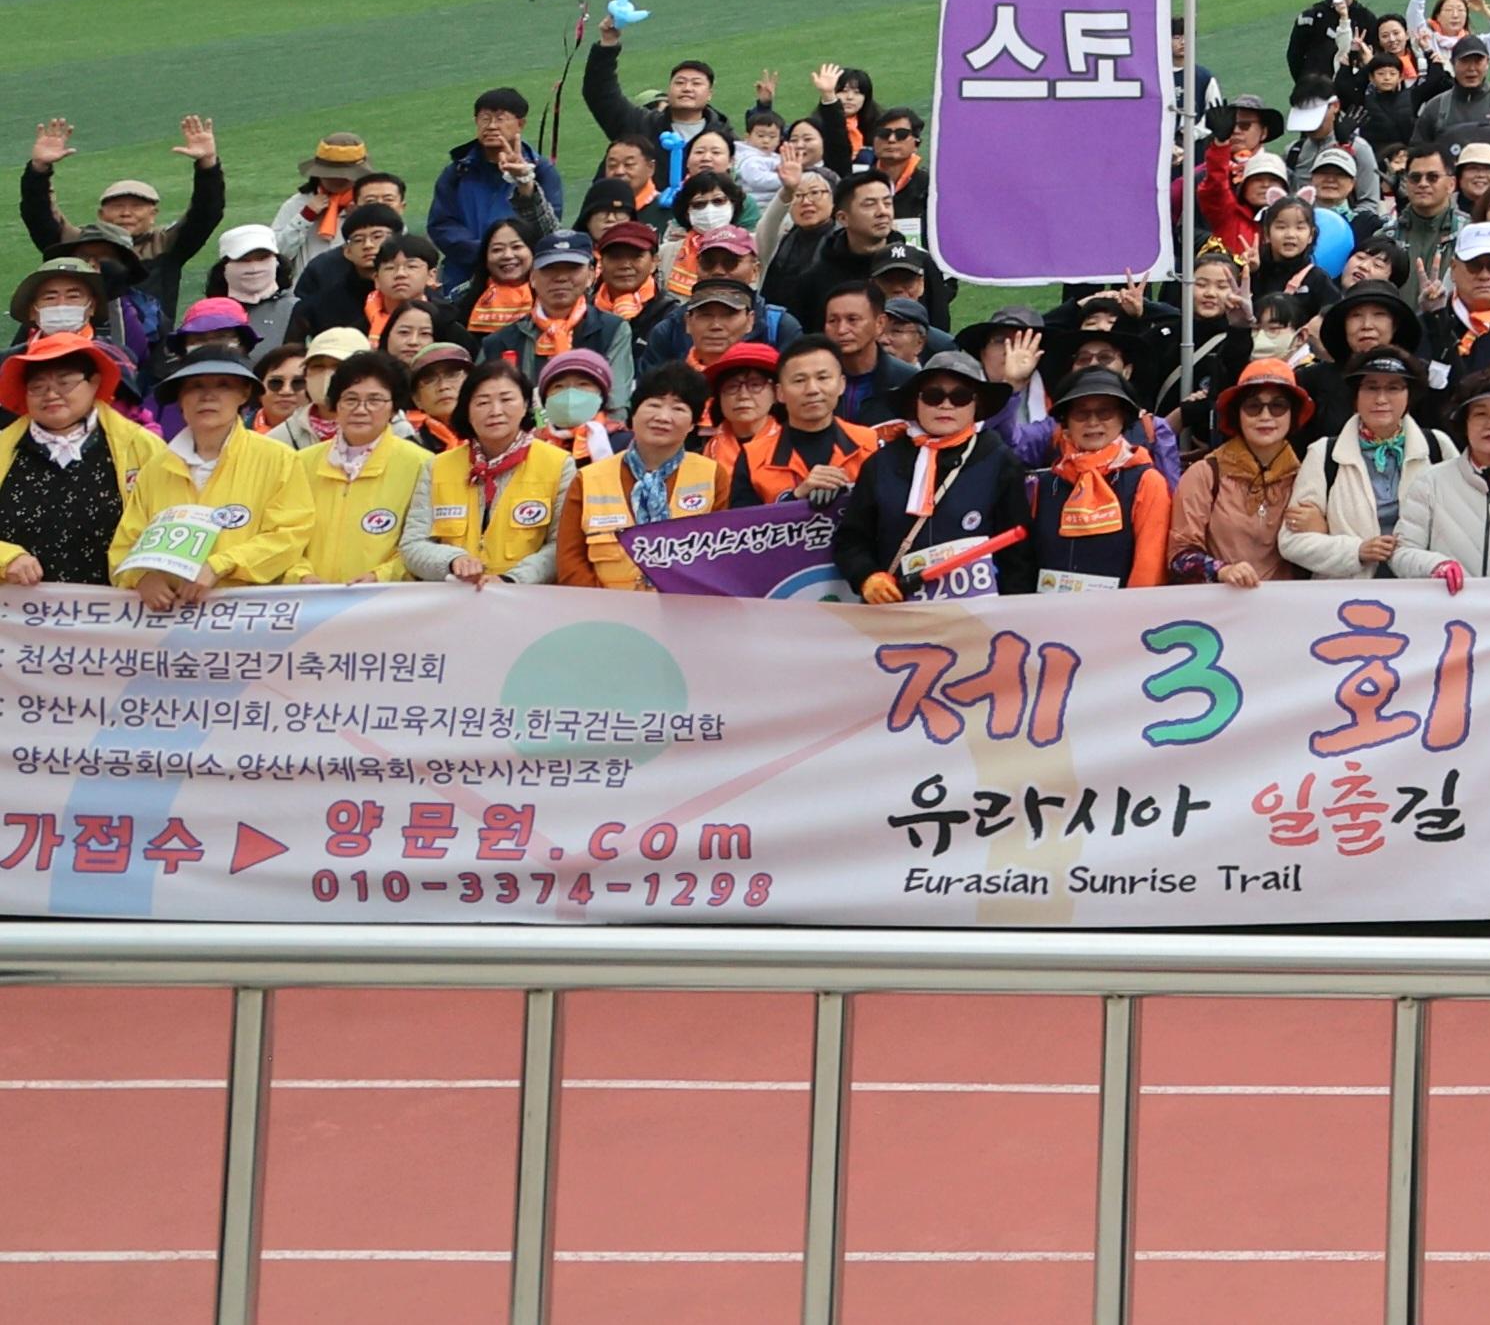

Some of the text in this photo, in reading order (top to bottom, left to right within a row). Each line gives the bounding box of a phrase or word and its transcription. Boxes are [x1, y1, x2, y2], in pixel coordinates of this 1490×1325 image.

[633, 516, 835, 567] 천성산생태숲
[22, 600, 300, 631] 양산도시문화연구원
[17, 645, 446, 684] 천성산생태숲길걷기축제위원회
[876, 598, 1478, 758] 제 3 회
[325, 799, 755, 862] 양문원.com
[887, 761, 1466, 858] 유라시아 일출길
[311, 868, 775, 907] 010-3374-1298
[903, 863, 1303, 896] Eurasian Sunrise Trail
